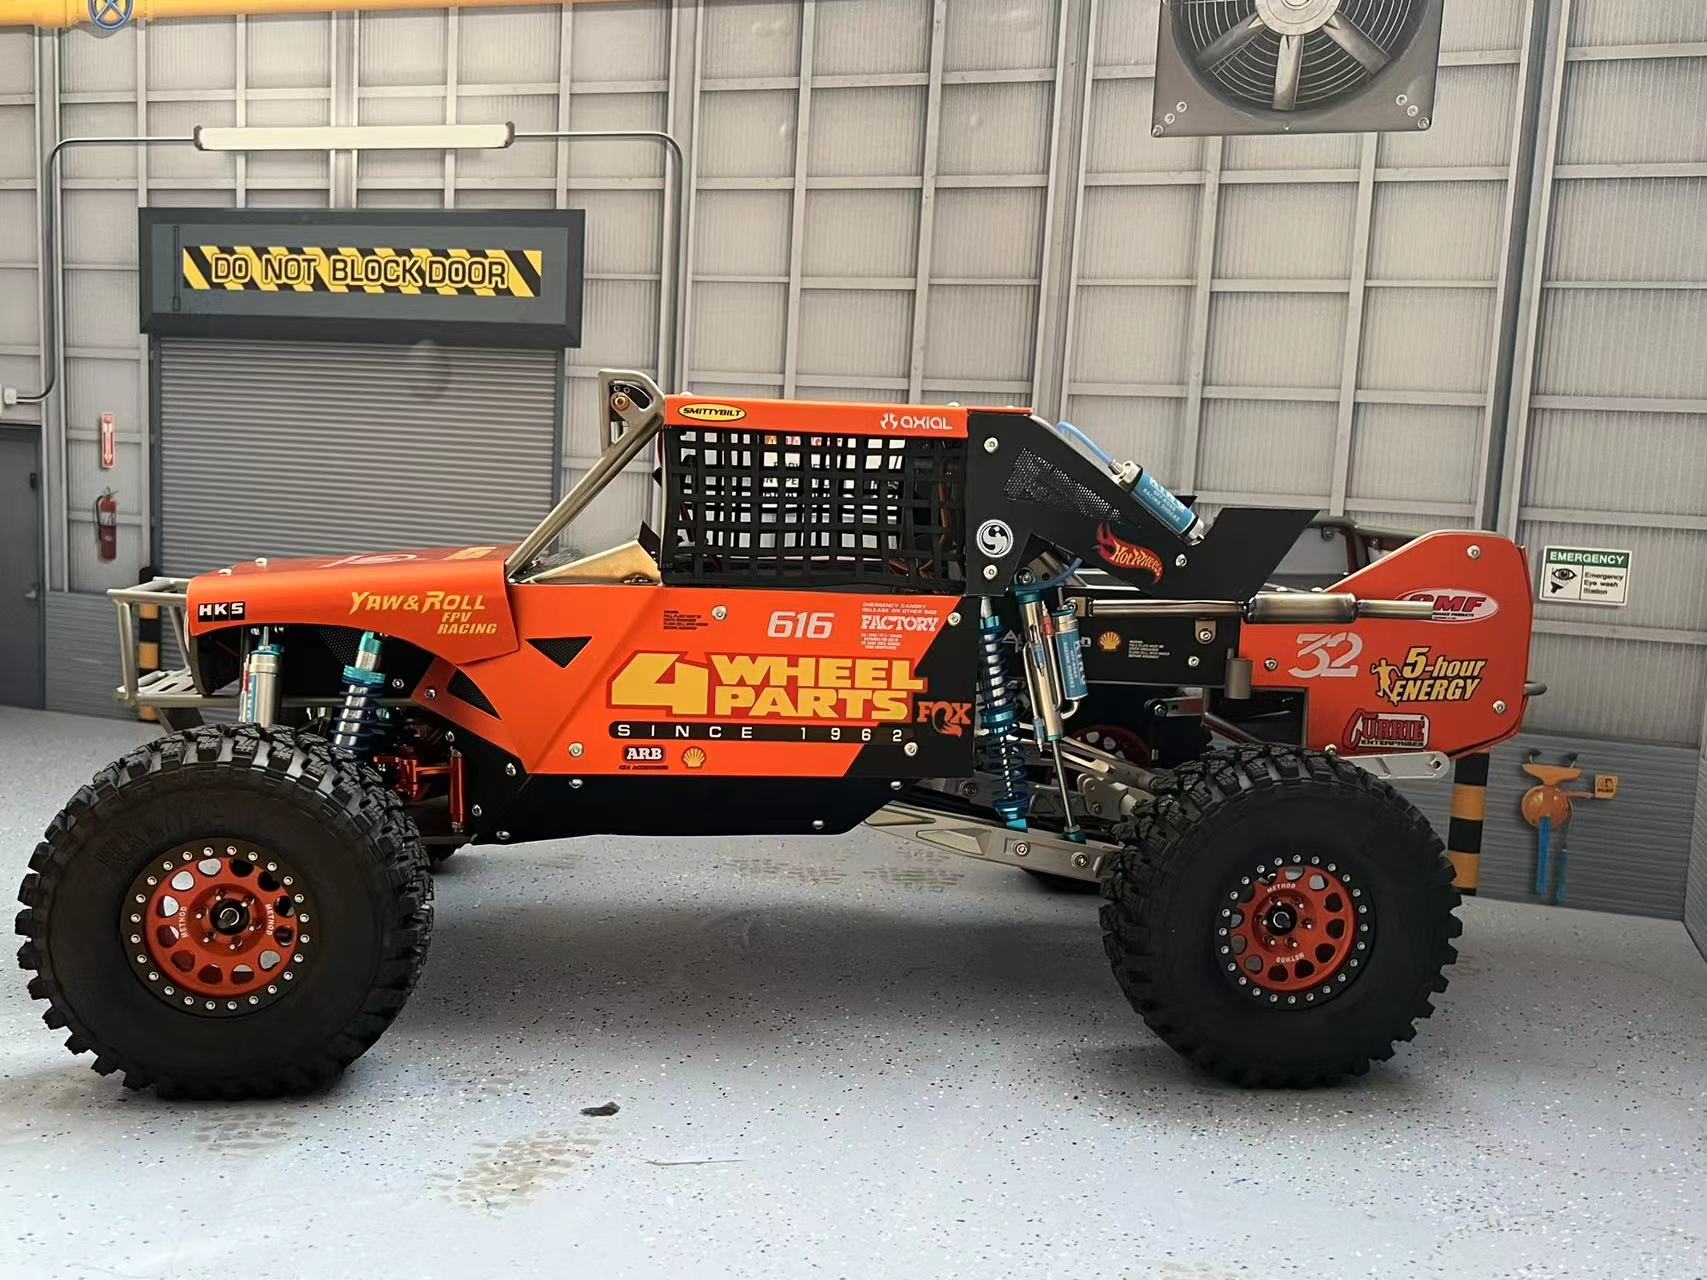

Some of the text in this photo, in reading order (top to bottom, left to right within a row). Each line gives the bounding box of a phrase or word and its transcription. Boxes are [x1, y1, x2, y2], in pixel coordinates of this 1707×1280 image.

[212, 255, 509, 288] DO NOT BLOCK DOOR
[683, 407, 741, 418] SMITTYBILT
[1550, 551, 1625, 565] EMERGENCY
[1584, 579, 1598, 587] Eye
[1585, 572, 1624, 582] Emergency
[199, 602, 244, 617] HKS
[442, 612, 472, 623] FPV
[437, 623, 497, 635] RACING
[767, 610, 836, 639] 616
[860, 614, 940, 632] FACTORY
[1288, 632, 1364, 679] 32
[1402, 647, 1487, 679] 5-hour
[611, 653, 925, 715] 4 WHEEL
[1392, 678, 1481, 701] ENERGY
[715, 686, 909, 720] PARTS
[917, 702, 973, 737] FOX
[1342, 708, 1425, 750] CURRIE
[617, 724, 903, 743] SINCE 1962
[627, 747, 662, 760] ARB
[1266, 883, 1297, 894] METHOD
[265, 903, 275, 937] METHOD
